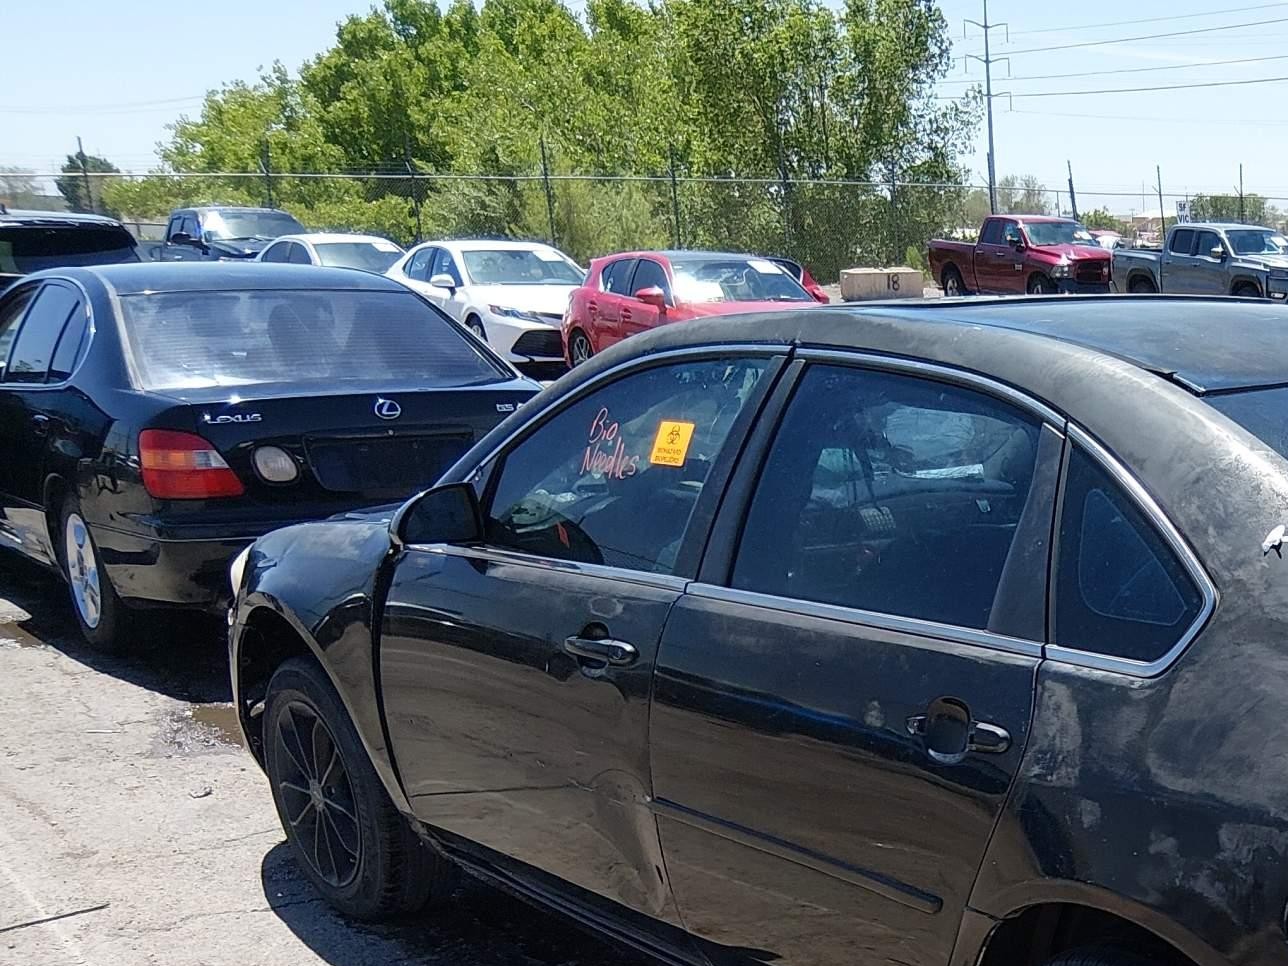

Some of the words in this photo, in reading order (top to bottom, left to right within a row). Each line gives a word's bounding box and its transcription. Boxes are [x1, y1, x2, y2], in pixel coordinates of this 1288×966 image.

[887, 274, 900, 291] 18
[203, 413, 262, 424] LEXUS
[588, 407, 618, 443] Bio
